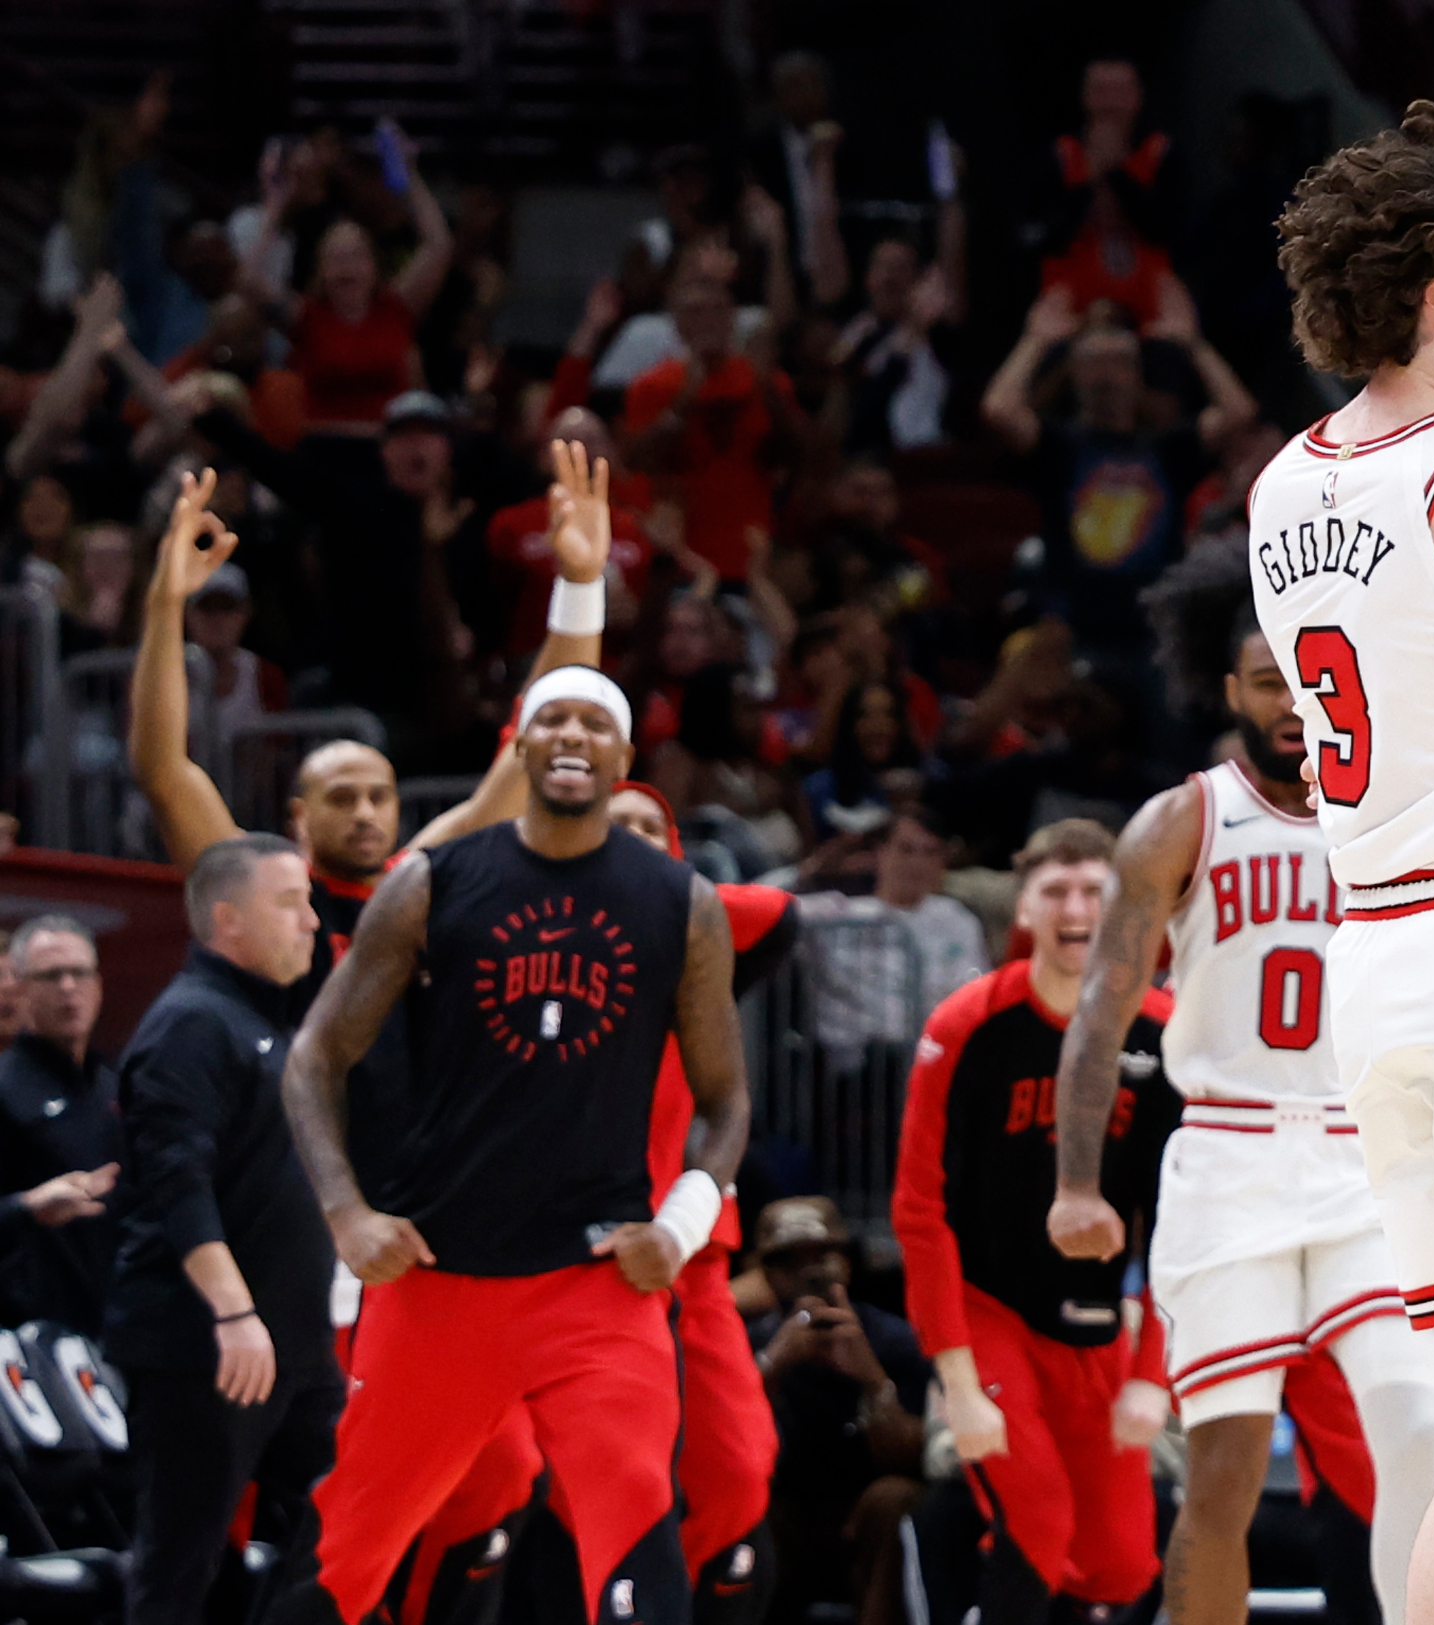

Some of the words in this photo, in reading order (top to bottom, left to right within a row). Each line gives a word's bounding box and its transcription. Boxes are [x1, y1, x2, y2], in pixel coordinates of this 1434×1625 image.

[1258, 517, 1396, 595] GIDDEY
[1295, 626, 1372, 808] 3
[1209, 851, 1345, 946] BULL
[504, 950, 610, 1010] BULLS
[1258, 946, 1324, 1051] 0
[1004, 1076, 1138, 1140] BUS
[53, 1334, 129, 1450] G
